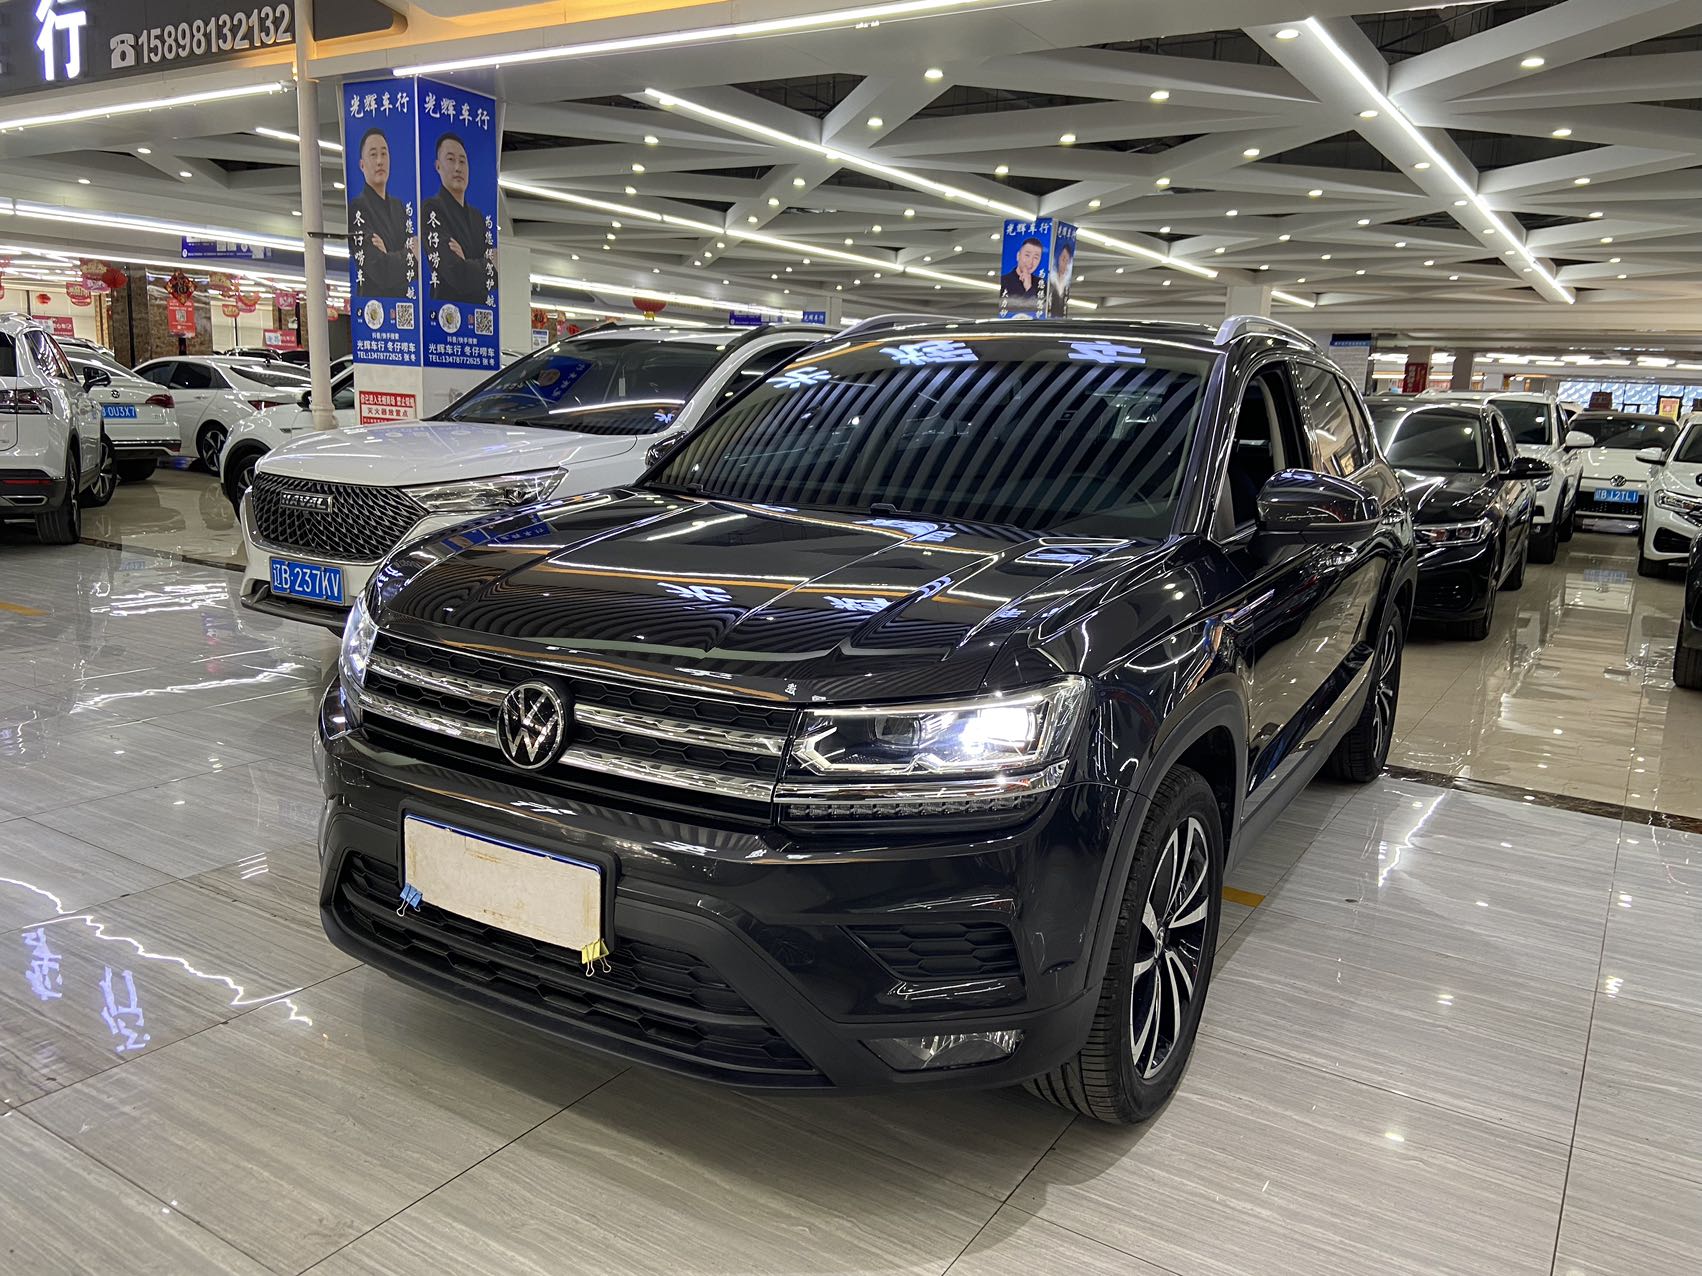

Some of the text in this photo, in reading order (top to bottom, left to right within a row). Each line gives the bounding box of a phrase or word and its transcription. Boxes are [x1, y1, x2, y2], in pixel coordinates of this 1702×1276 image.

[138, 2, 293, 64] 15898132132
[350, 91, 410, 119] 光辉车行
[424, 92, 491, 131] 光辉车行
[357, 340, 385, 352] 光辉车行
[428, 343, 462, 355] 光辉车行
[281, 494, 327, 510] HAVAL
